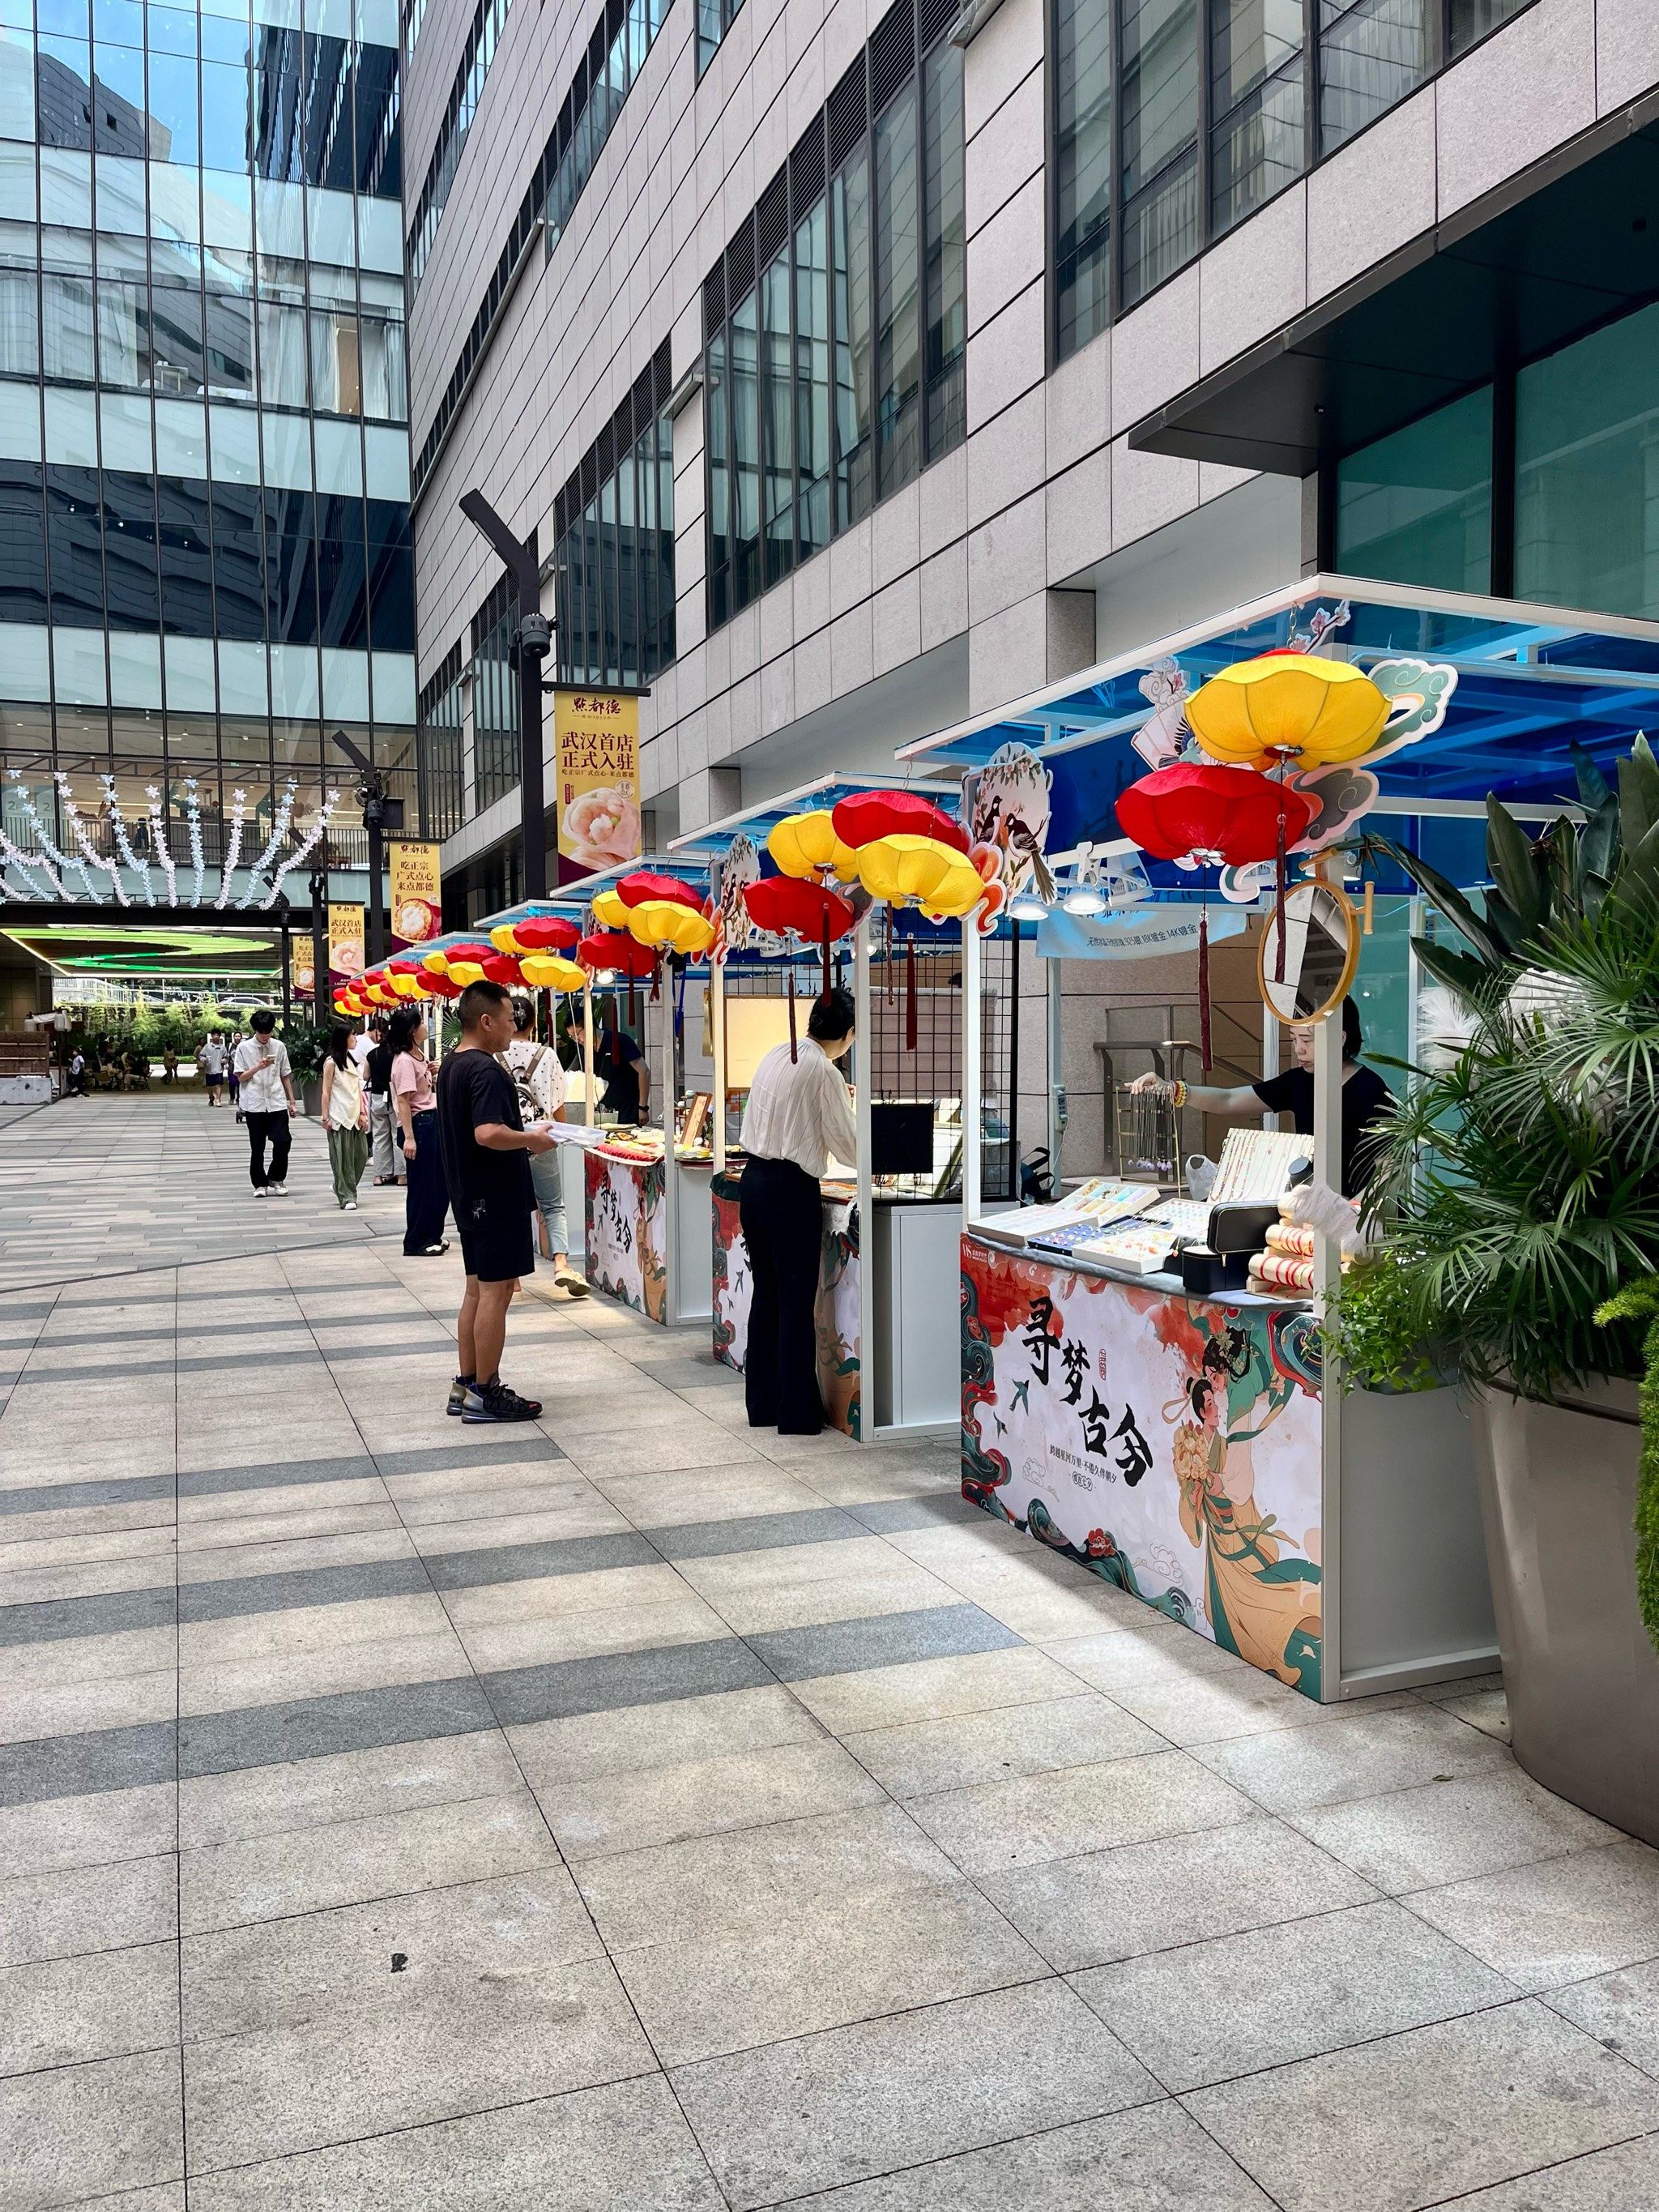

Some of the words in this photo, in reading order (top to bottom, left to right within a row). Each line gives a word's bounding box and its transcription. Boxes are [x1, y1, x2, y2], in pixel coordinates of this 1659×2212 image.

[561, 731, 633, 753] 武汉首店
[561, 749, 635, 771] 正式入驻
[400, 861, 429, 870] 吃正宗
[396, 871, 434, 881] 广式点心
[397, 882, 434, 891] 来点都德
[331, 919, 361, 927] 武汉首店
